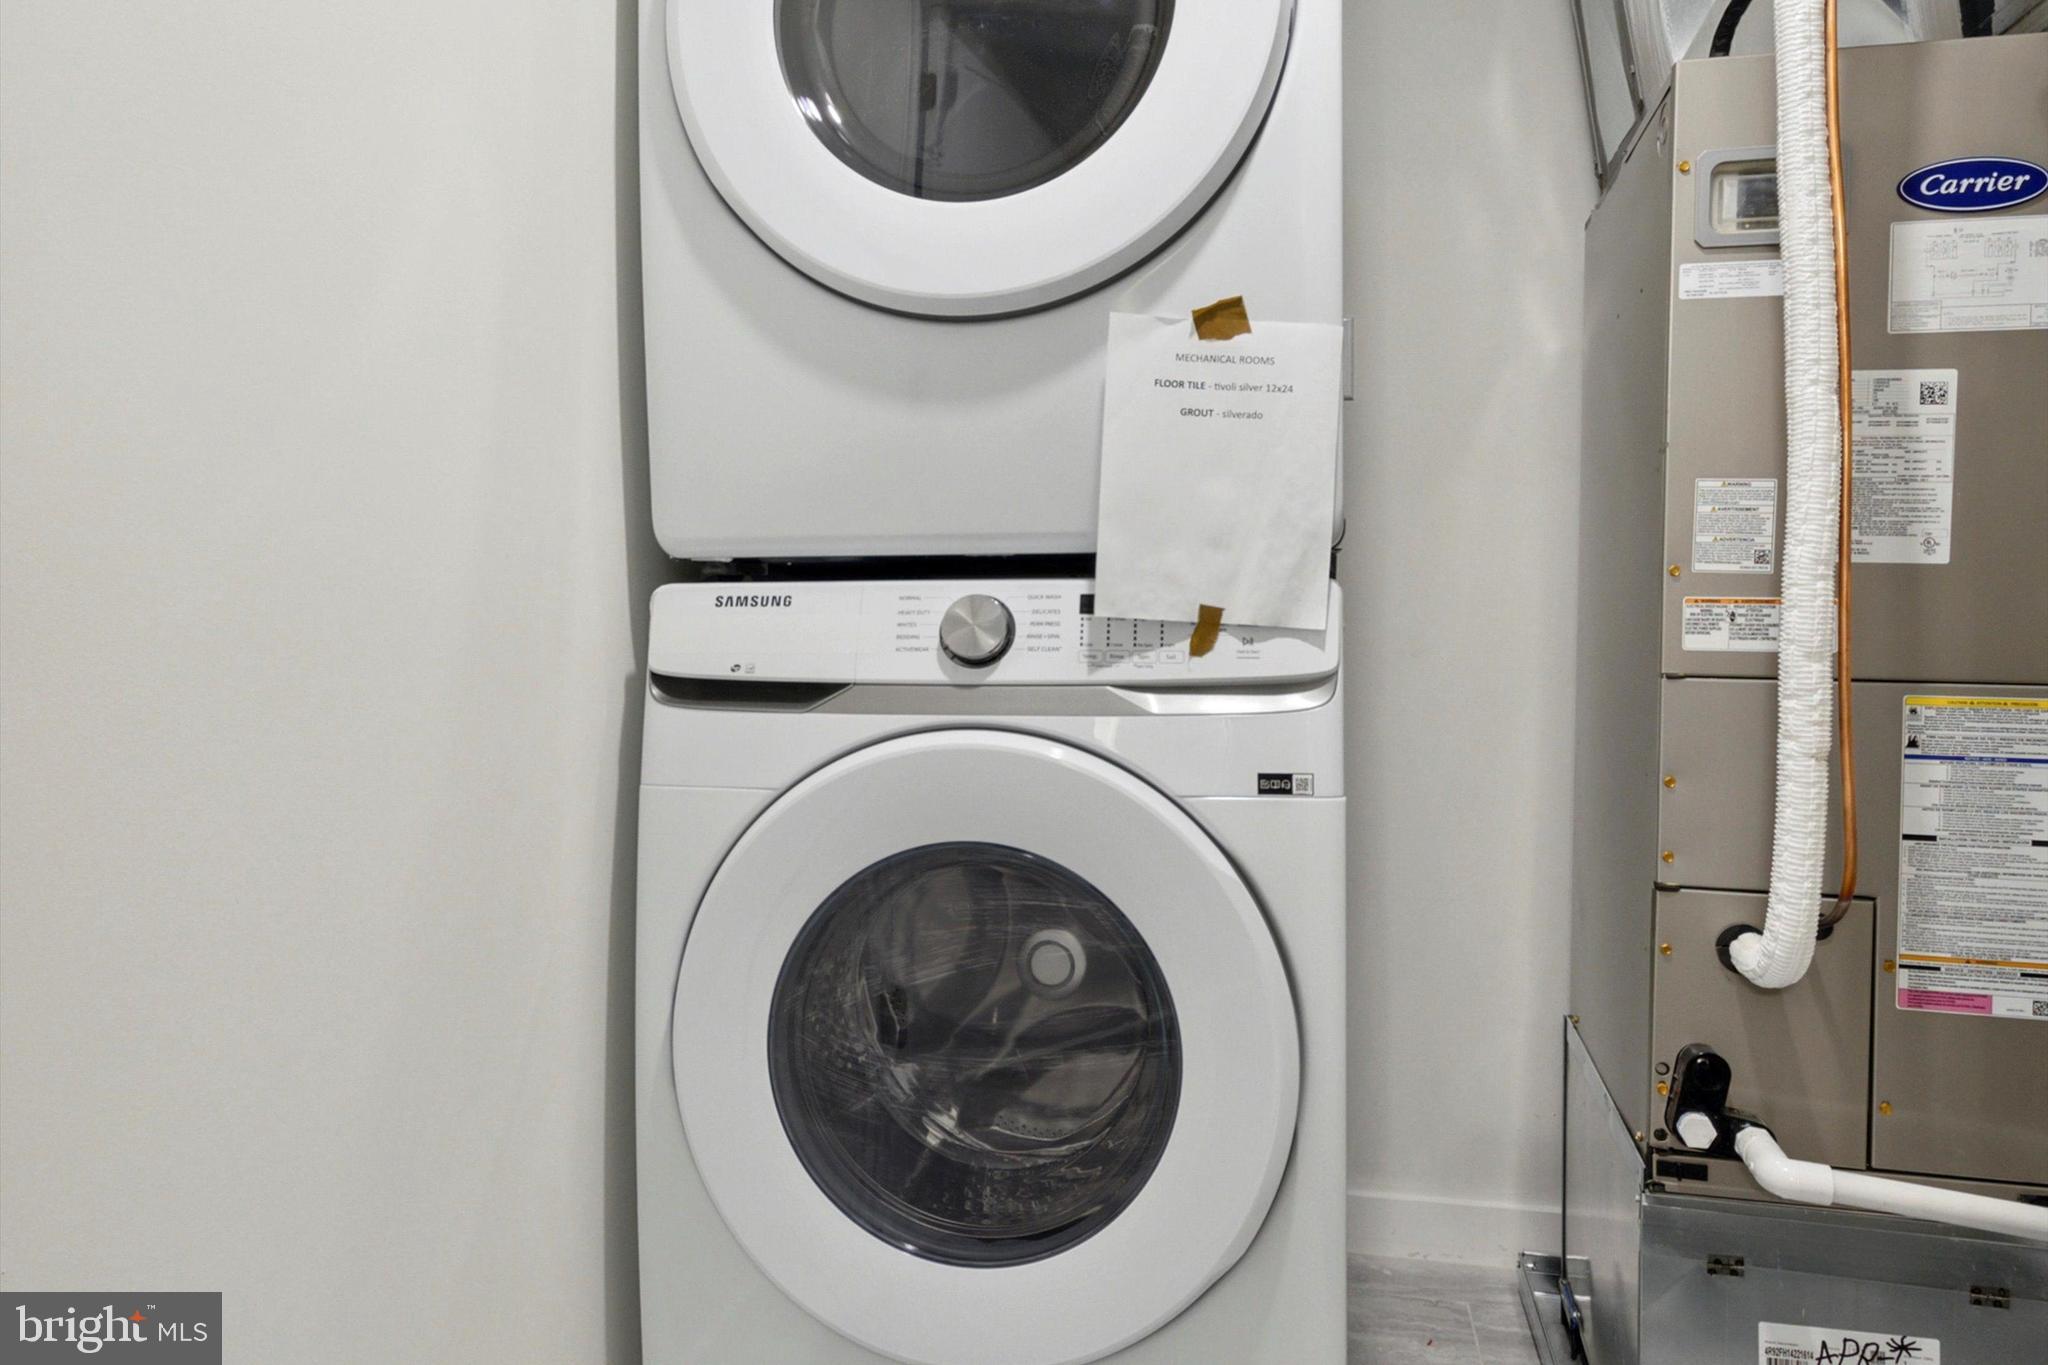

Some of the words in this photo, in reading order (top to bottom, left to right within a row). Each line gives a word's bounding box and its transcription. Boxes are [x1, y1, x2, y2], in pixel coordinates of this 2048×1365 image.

[1920, 172, 2031, 196] Carrier
[1175, 353, 1237, 364] MECHANICAL
[1238, 355, 1276, 366] ROOMS
[1154, 379, 1185, 389] FLOOR
[1187, 380, 1206, 390] TILE
[1213, 381, 1237, 392] tivoli
[1238, 383, 1263, 393] silver
[1266, 384, 1294, 394] 12x24
[1180, 407, 1214, 418] GROUT
[1221, 410, 1264, 420] silverado
[714, 595, 793, 608] SAMSUNG
